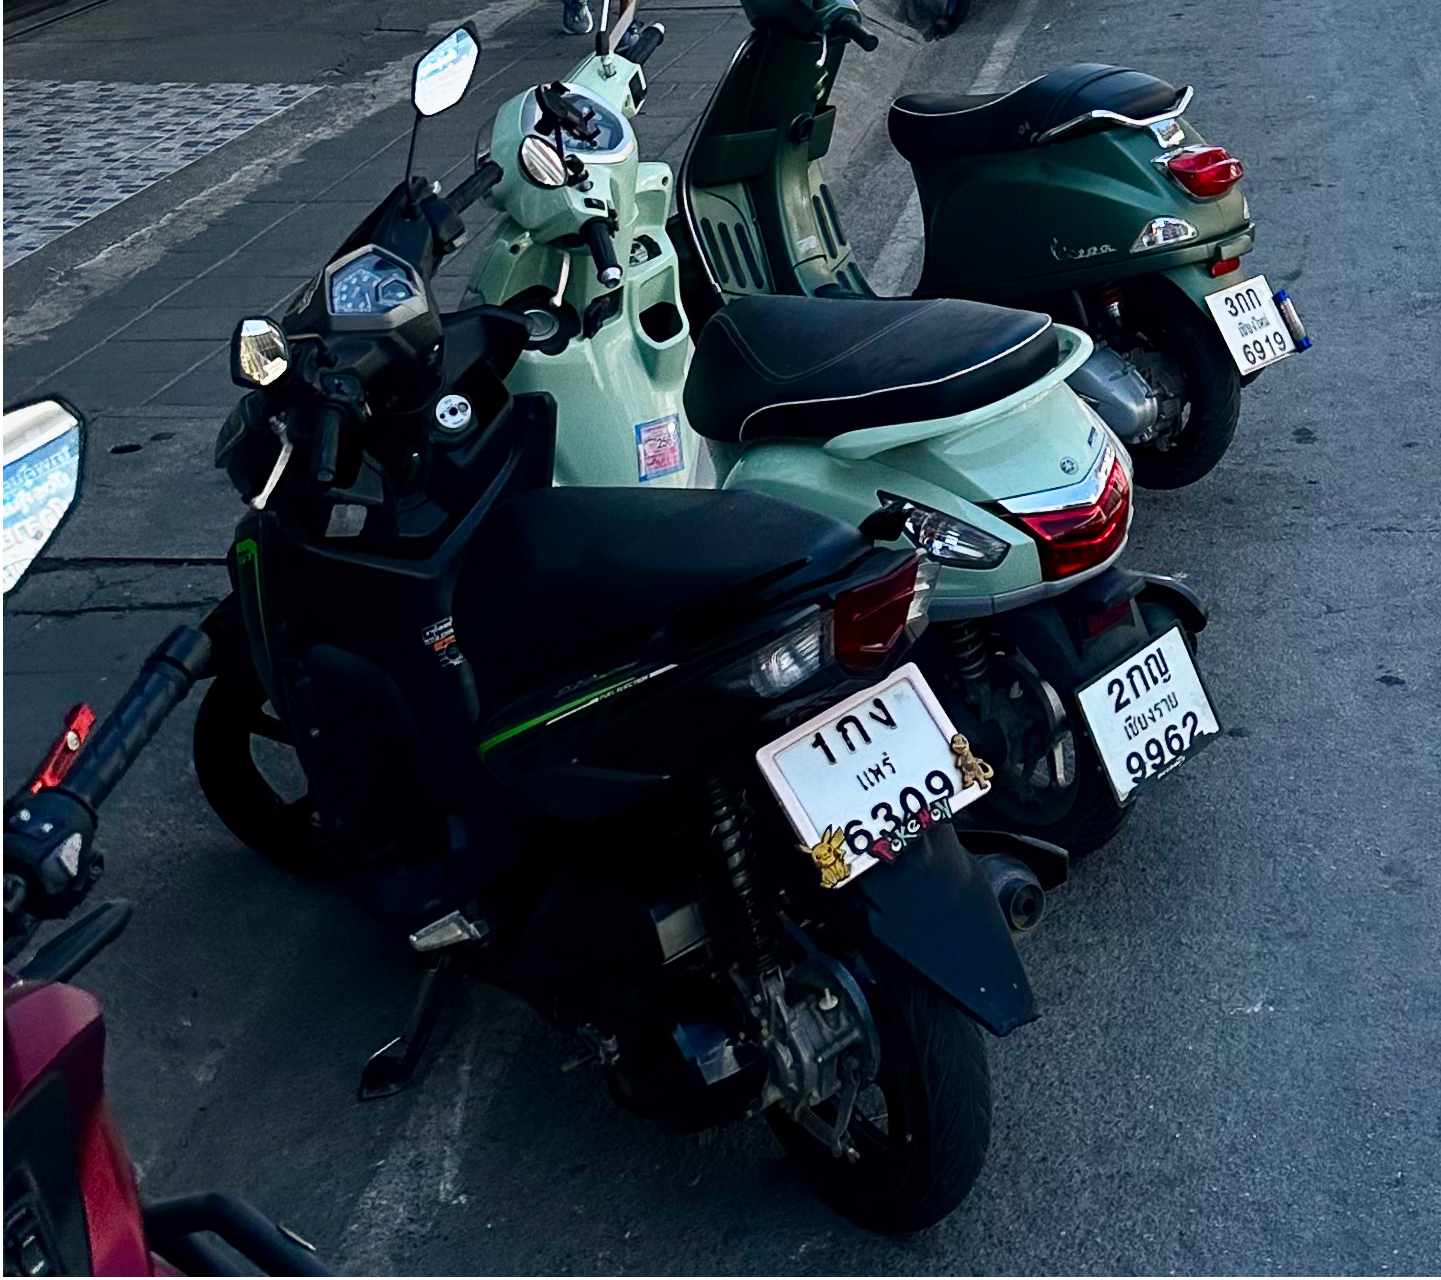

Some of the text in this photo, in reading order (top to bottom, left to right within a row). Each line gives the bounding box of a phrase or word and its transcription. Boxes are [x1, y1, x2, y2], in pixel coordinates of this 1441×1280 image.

[1224, 288, 1262, 317] 3กก
[1242, 331, 1287, 365] 6919
[1108, 647, 1172, 714] 2กญ
[811, 697, 898, 765] 1กง
[1124, 692, 1179, 741] เชียงราย
[856, 752, 897, 790] แพร่
[1126, 711, 1198, 784] 9962
[844, 770, 955, 855] 6309
